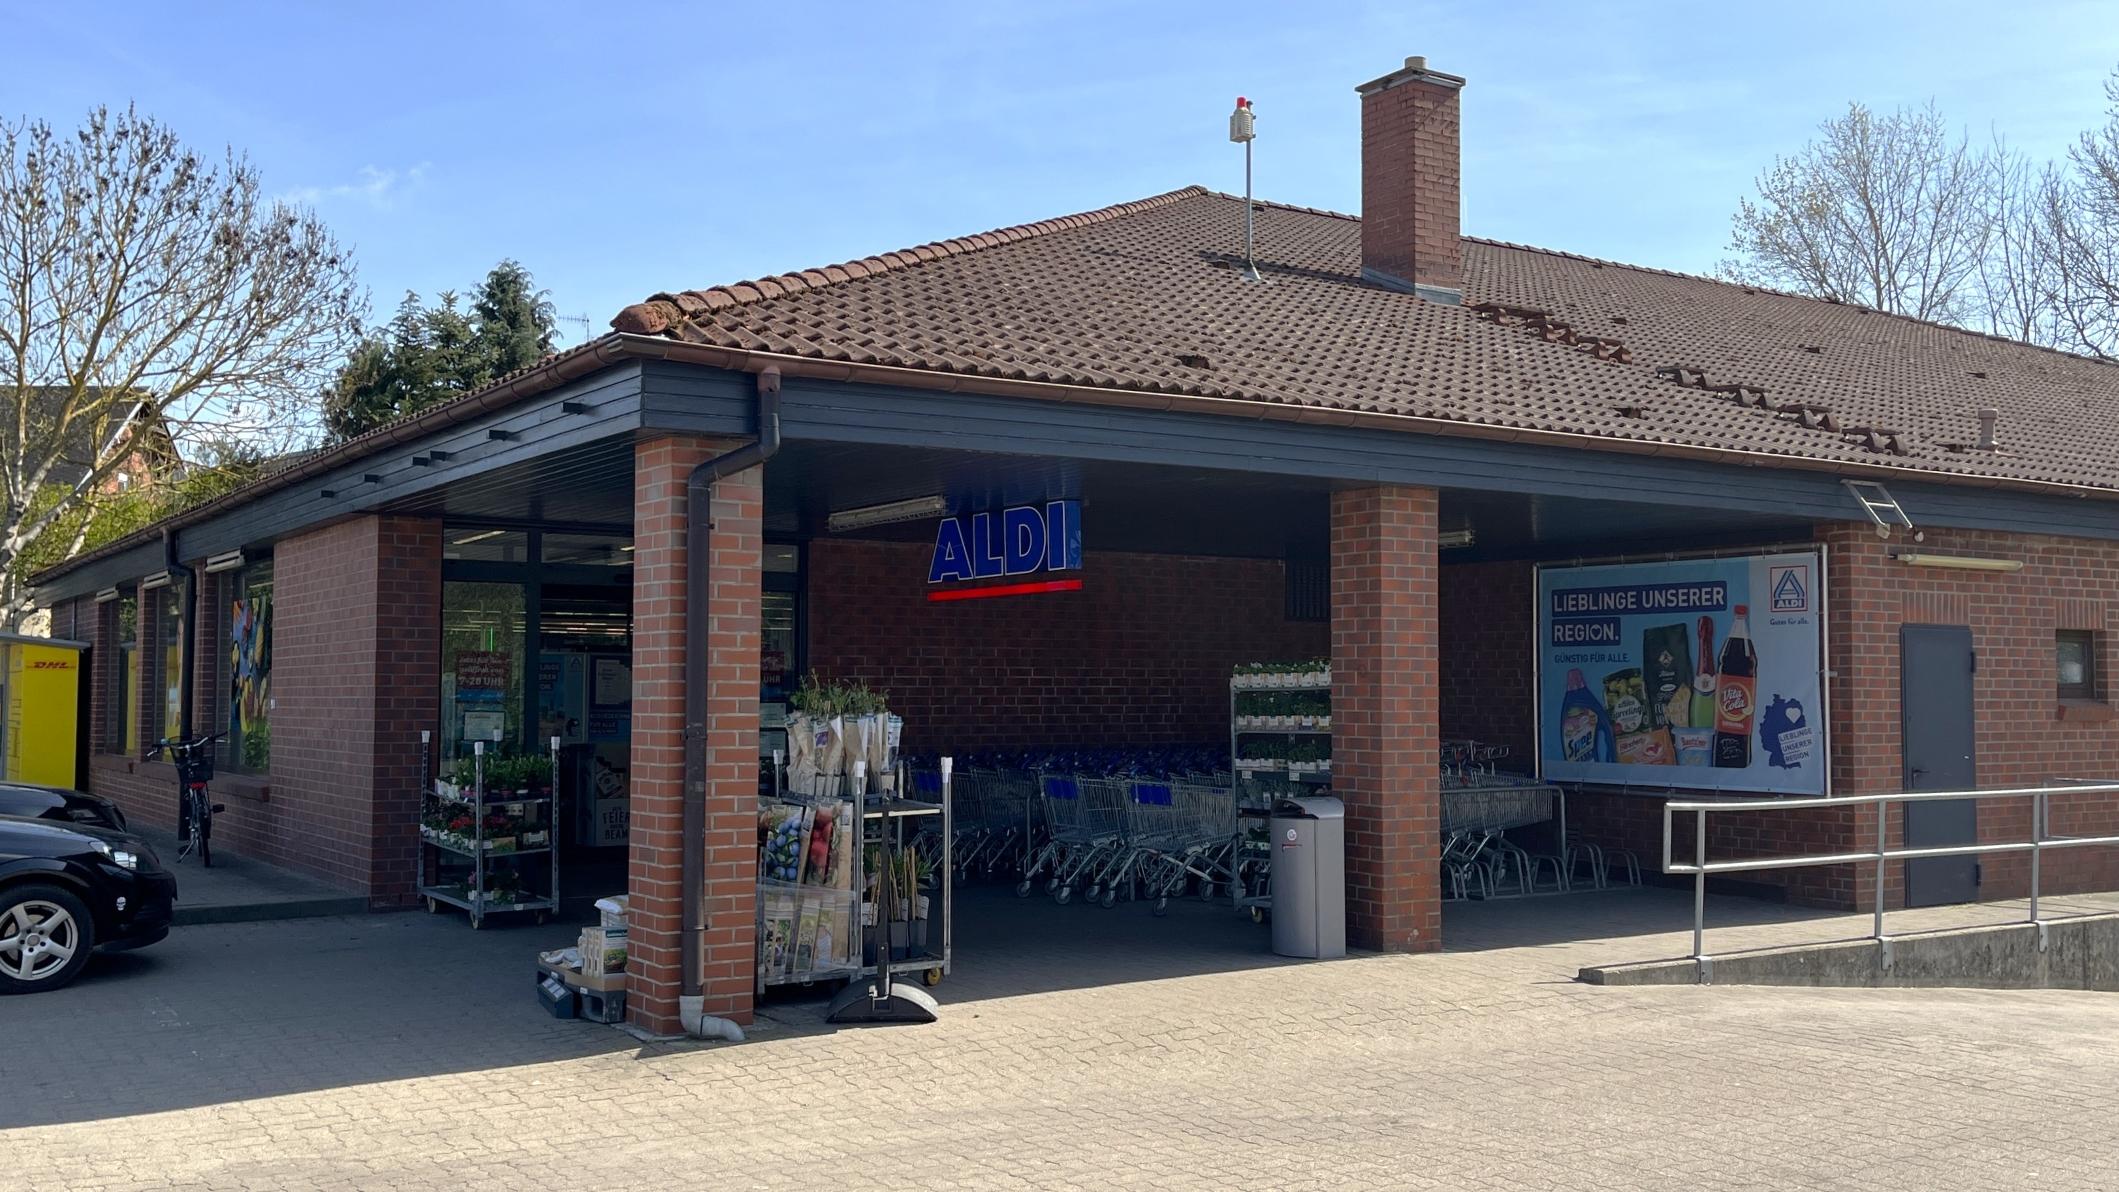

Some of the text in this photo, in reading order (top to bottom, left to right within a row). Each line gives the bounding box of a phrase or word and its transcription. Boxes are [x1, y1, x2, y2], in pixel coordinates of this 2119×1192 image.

[928, 500, 1067, 584] ALDI
[1553, 585, 1725, 612] LIEBLINGE UNSERER
[1776, 598, 1803, 608] ALDI
[1554, 622, 1619, 642] REGION.
[1554, 653, 1588, 663] GÜNSTIG
[1590, 652, 1605, 663] FÜR
[34, 661, 69, 669] DHL
[1723, 688, 1743, 702] Vita
[1725, 697, 1746, 712] Cola
[1780, 728, 1813, 742] LIEBLINGE
[1782, 740, 1812, 753] UNSERER
[1785, 752, 1810, 763] REGION
